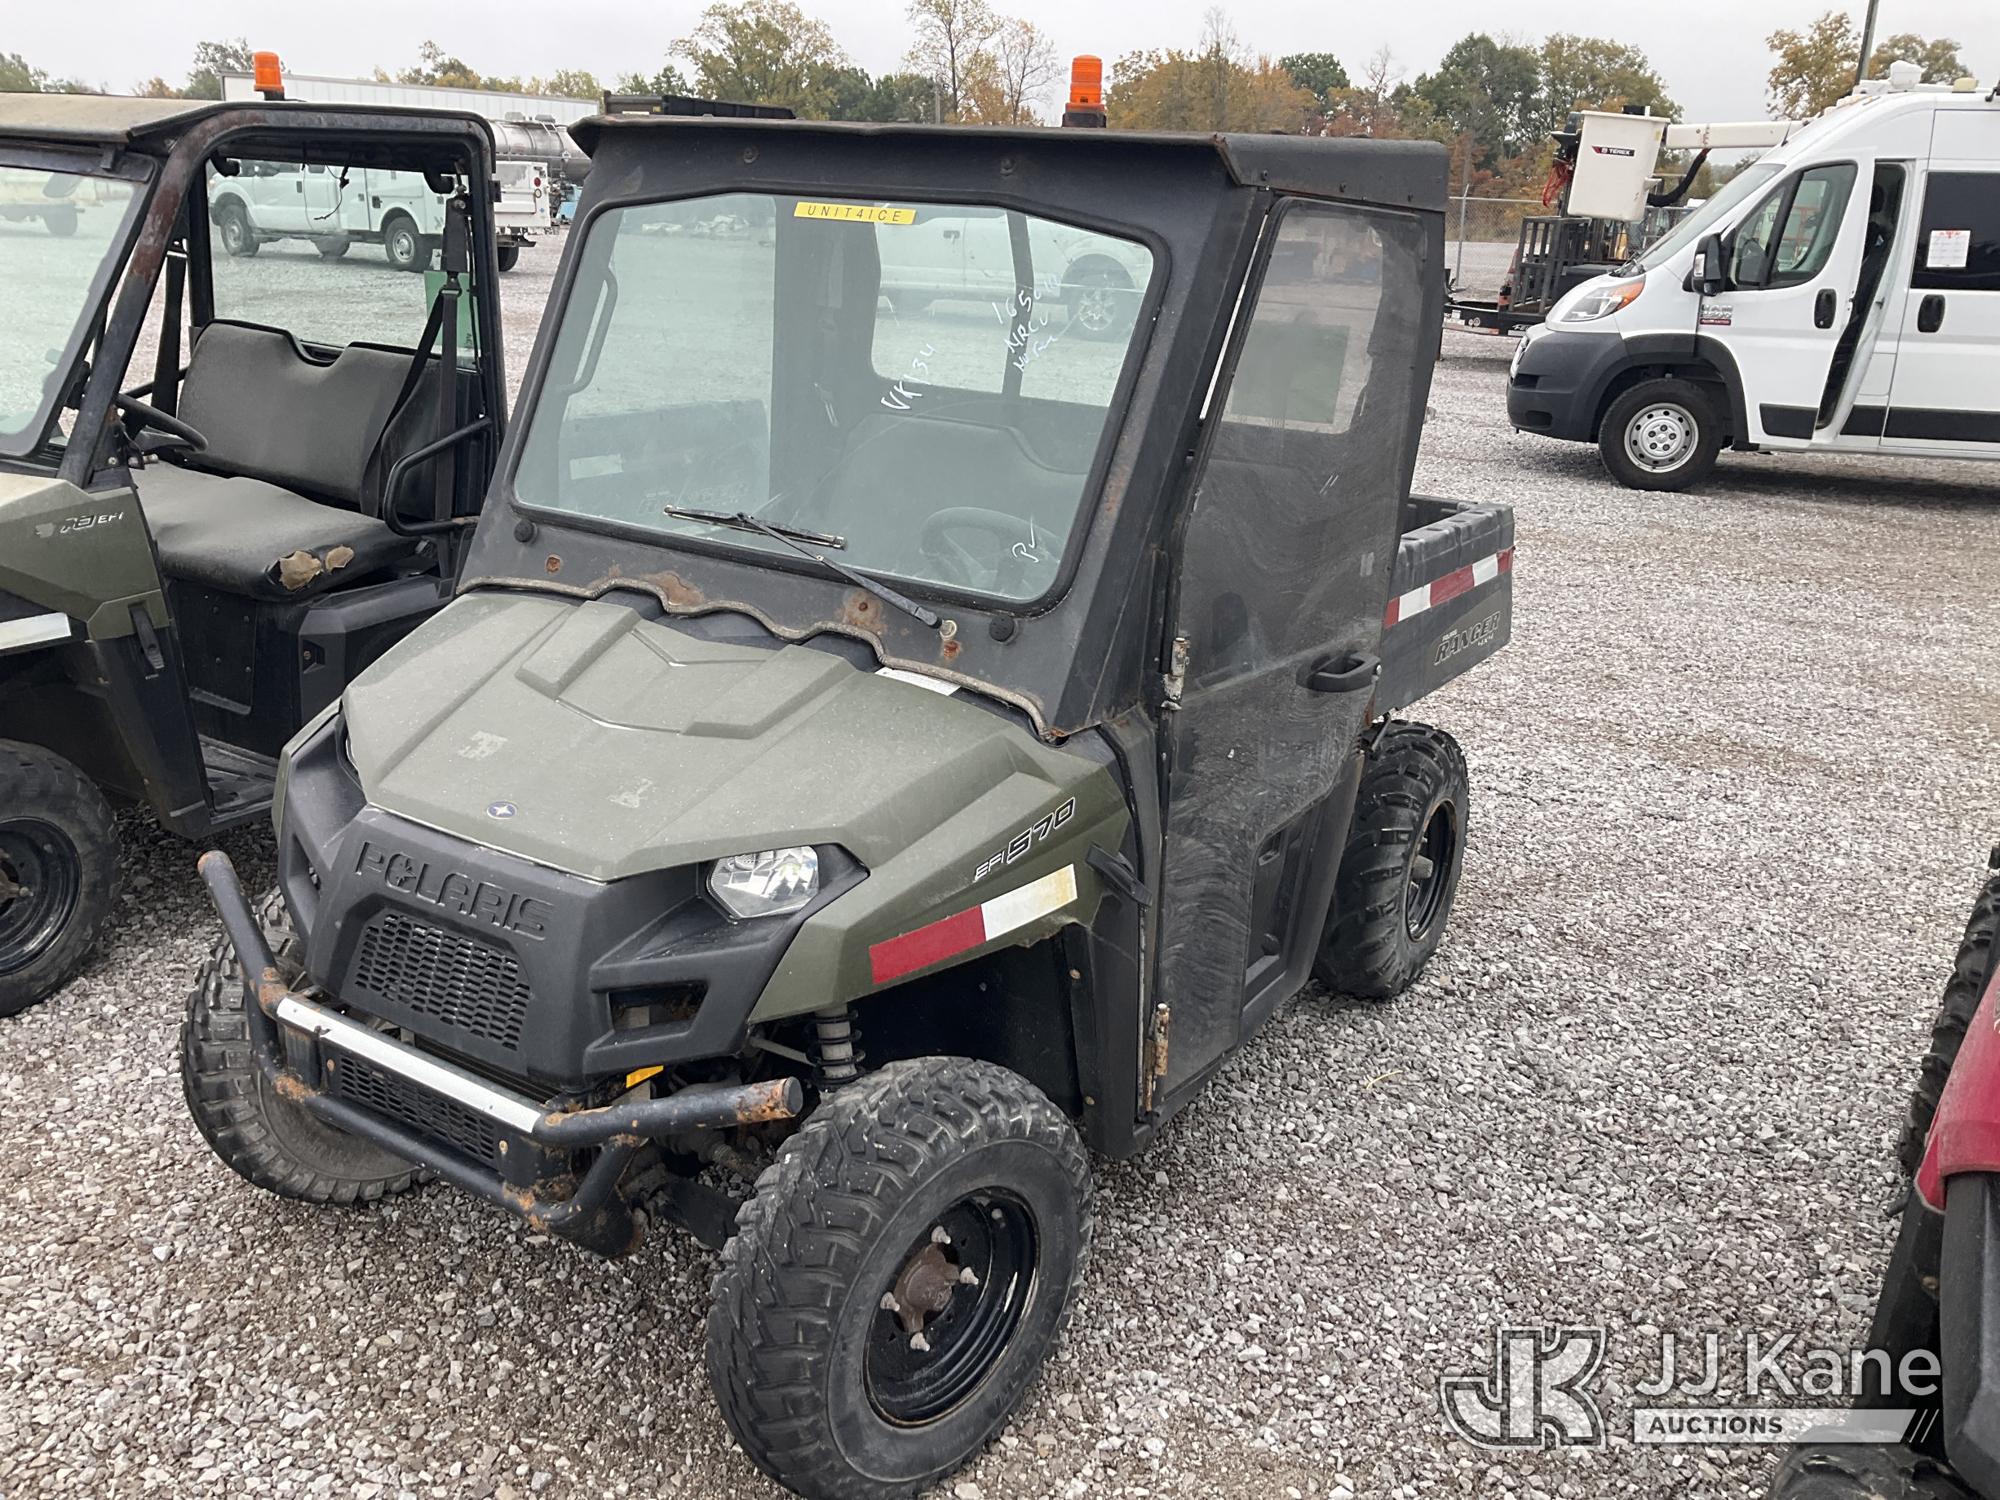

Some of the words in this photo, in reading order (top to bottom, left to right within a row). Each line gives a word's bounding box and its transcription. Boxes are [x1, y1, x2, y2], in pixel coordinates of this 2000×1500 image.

[1433, 610, 1501, 666] RANGER
[972, 851, 1005, 883] EFI
[1006, 796, 1076, 865] 570
[355, 841, 555, 941] POLARIS
